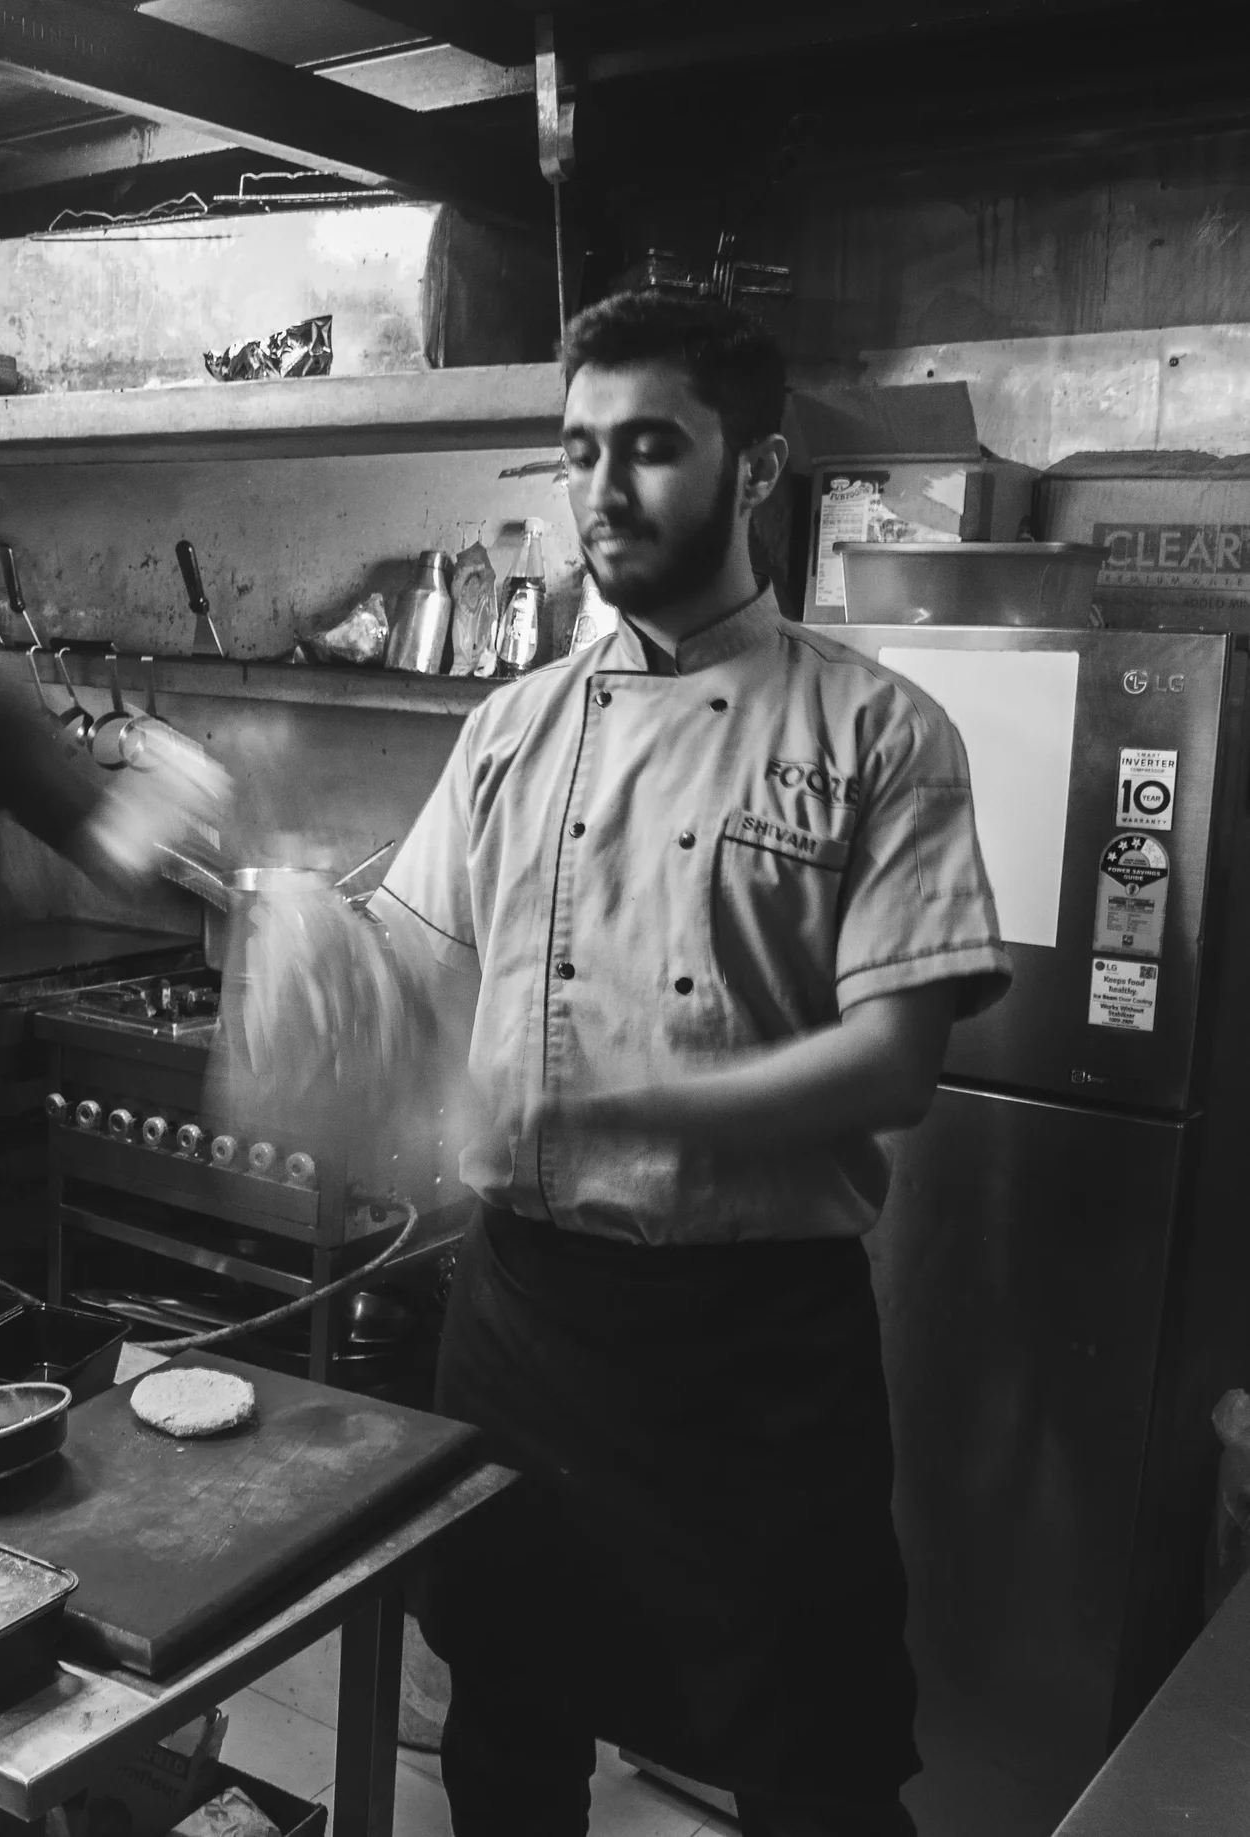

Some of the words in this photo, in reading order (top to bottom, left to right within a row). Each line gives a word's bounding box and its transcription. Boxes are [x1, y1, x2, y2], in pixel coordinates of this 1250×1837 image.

[1103, 530, 1241, 569] CLEAR
[1105, 575, 1180, 585] REMIUM
[1155, 673, 1185, 693] LG
[1121, 758, 1175, 768] INVERTER
[1121, 779, 1171, 816] 10
[1142, 794, 1161, 802] YEAR
[1121, 817, 1167, 825] WARRANTY
[742, 816, 817, 855] SHIVAM
[1107, 866, 1131, 874] POWER
[1132, 868, 1161, 877] SAVINGS
[1106, 963, 1118, 972] LG
[1103, 976, 1127, 986] Keeps
[1127, 978, 1146, 987] food
